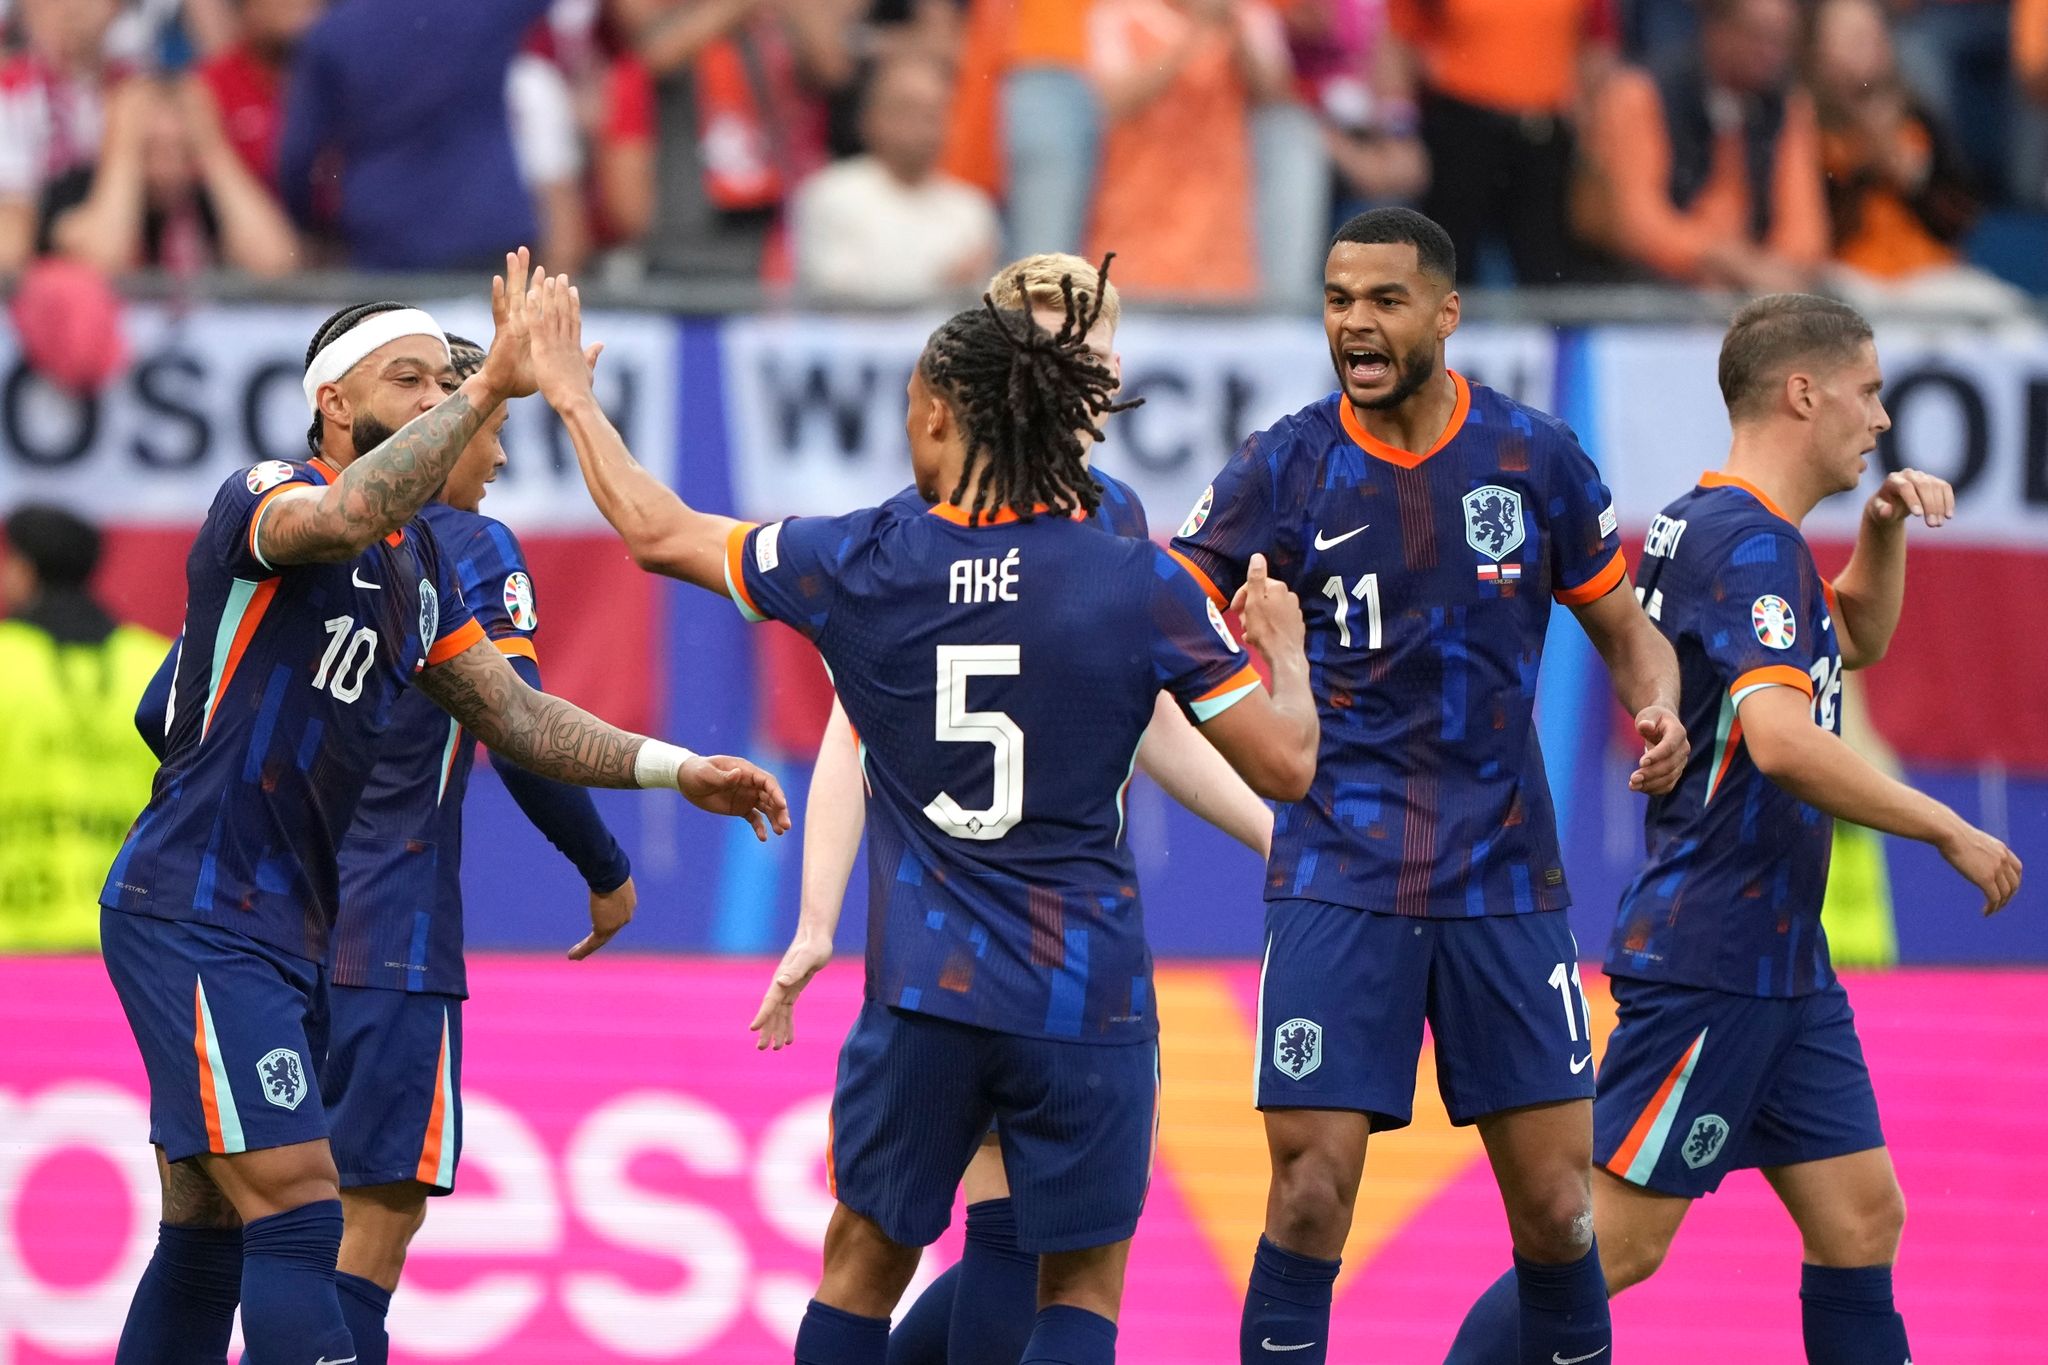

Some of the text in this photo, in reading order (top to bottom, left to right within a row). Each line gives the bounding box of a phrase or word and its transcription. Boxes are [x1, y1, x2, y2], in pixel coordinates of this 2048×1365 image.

[949, 548, 1020, 603] AKÉ
[1321, 573, 1382, 649] 11
[311, 614, 378, 704] 10
[922, 644, 1024, 840] 5
